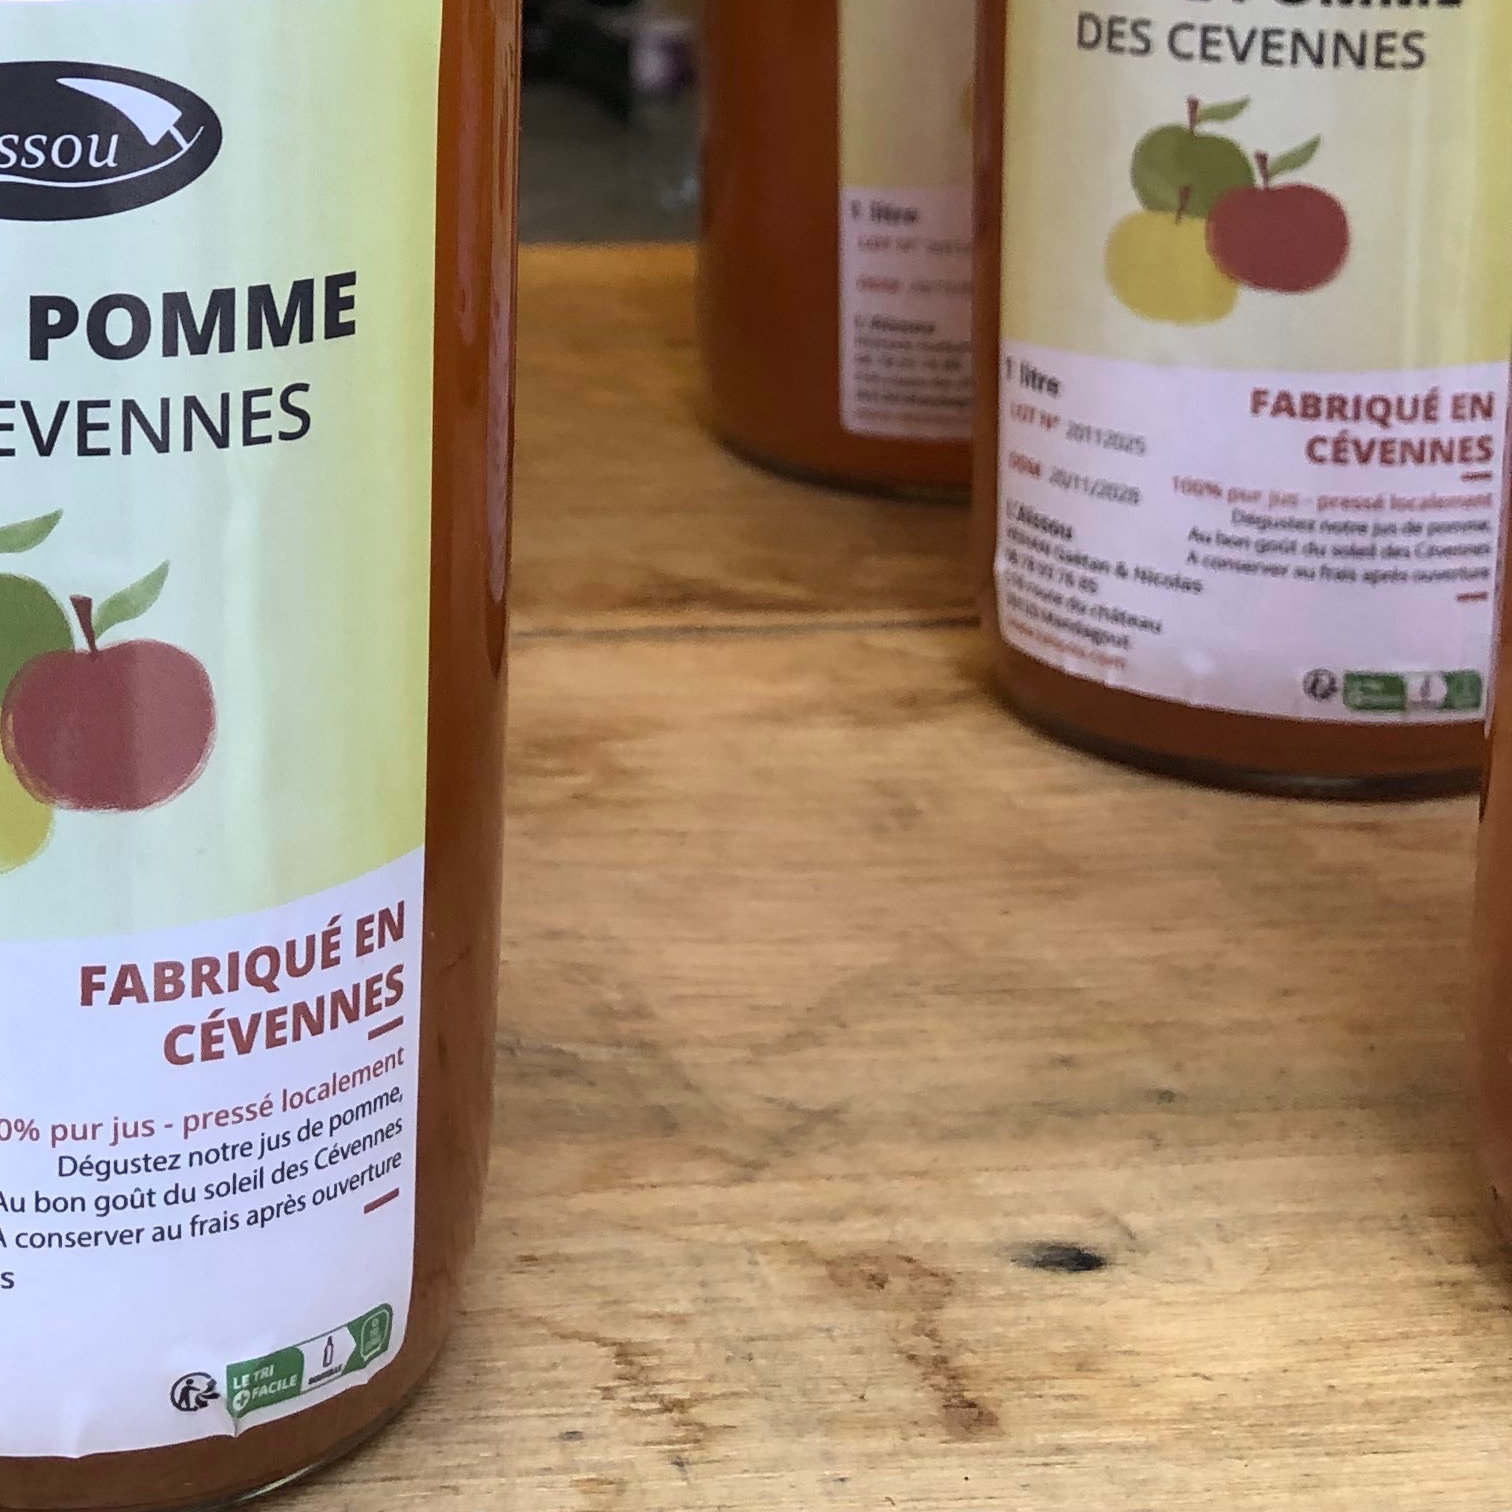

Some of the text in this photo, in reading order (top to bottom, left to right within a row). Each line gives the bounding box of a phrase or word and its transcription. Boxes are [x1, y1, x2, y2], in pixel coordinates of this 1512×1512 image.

[1077, 12, 1427, 70] DES CEVENNES
[29, 271, 357, 361] POMME
[1251, 388, 1495, 428] FABRIQUÉ EN
[1306, 430, 1494, 465] CÉVENNES
[80, 900, 405, 1007] FABRIQUÉ EN
[164, 963, 405, 1067] CÉVENNES
[51, 1122, 105, 1149] pur
[109, 1116, 155, 1147] jus
[183, 1093, 274, 1141] pressé
[282, 1045, 405, 1113] localement
[58, 1086, 404, 1183] Dégustez notre jus de pomme,
[15, 1227, 146, 1249] conserver
[151, 1224, 182, 1244] au
[190, 1209, 240, 1238] frais
[246, 1193, 307, 1230] après
[312, 1152, 403, 1207] ouverture
[35, 1190, 87, 1214] bon
[94, 1187, 157, 1218] goût
[163, 1183, 197, 1207] du
[204, 1166, 264, 1200] soleil
[271, 1159, 309, 1186] des
[313, 1117, 403, 1171] Cévennes
[233, 1364, 275, 1389] LE TRI
[252, 1374, 298, 1399] FACILE
